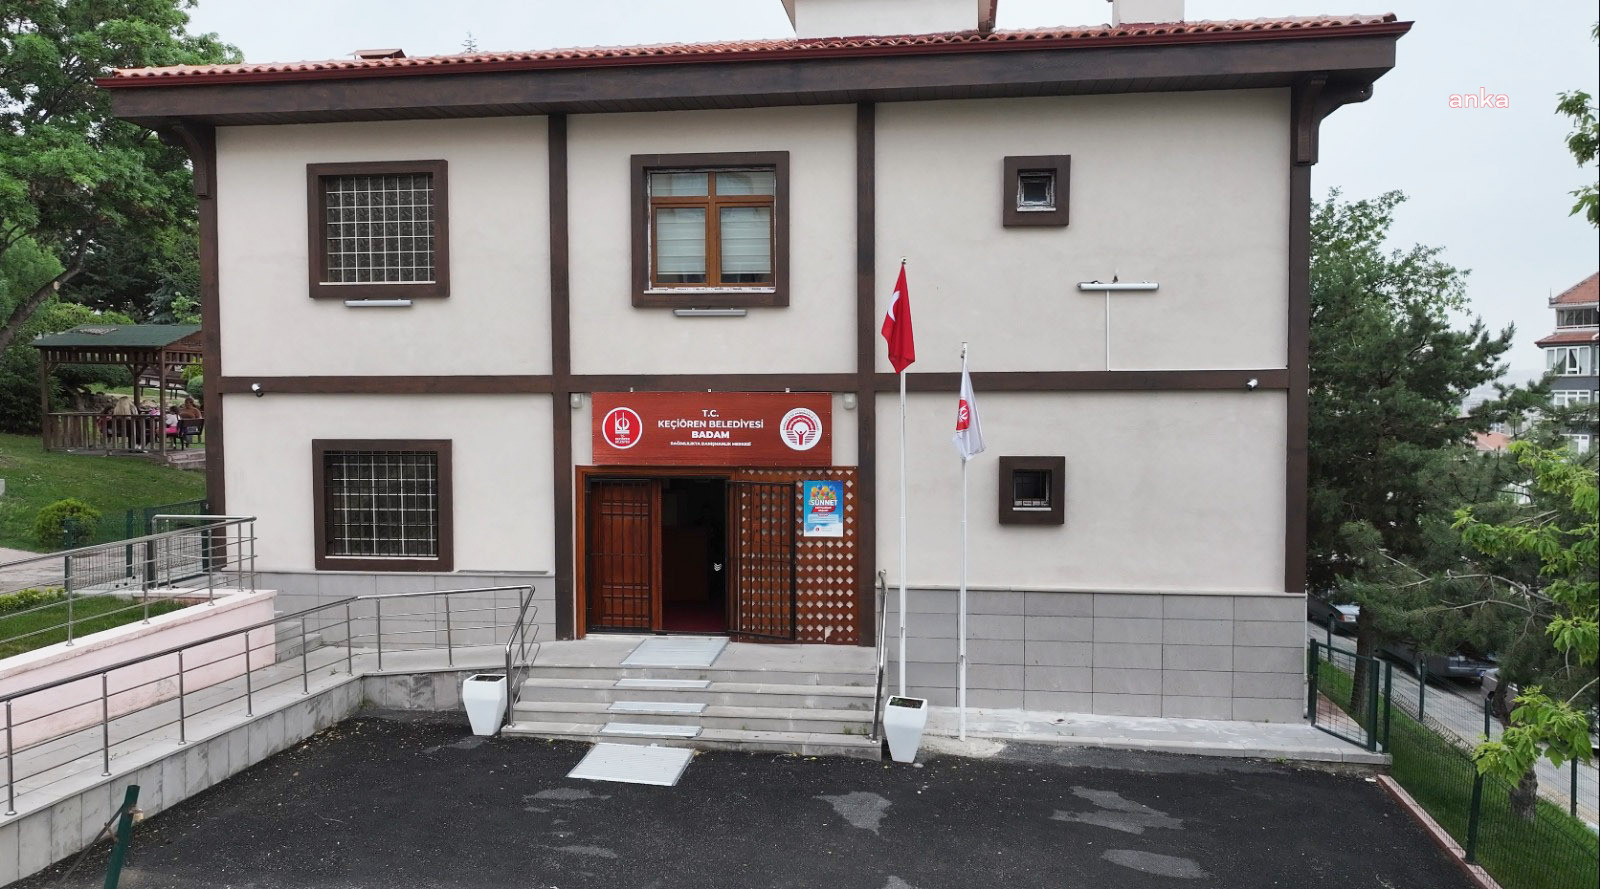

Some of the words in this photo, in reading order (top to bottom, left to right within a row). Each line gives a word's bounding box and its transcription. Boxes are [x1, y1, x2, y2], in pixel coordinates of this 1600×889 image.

[701, 409, 719, 418] T.C.
[658, 419, 706, 430] KEÇİÖREN
[709, 419, 764, 428] BELEDİYESİ
[691, 431, 730, 439] BADAM
